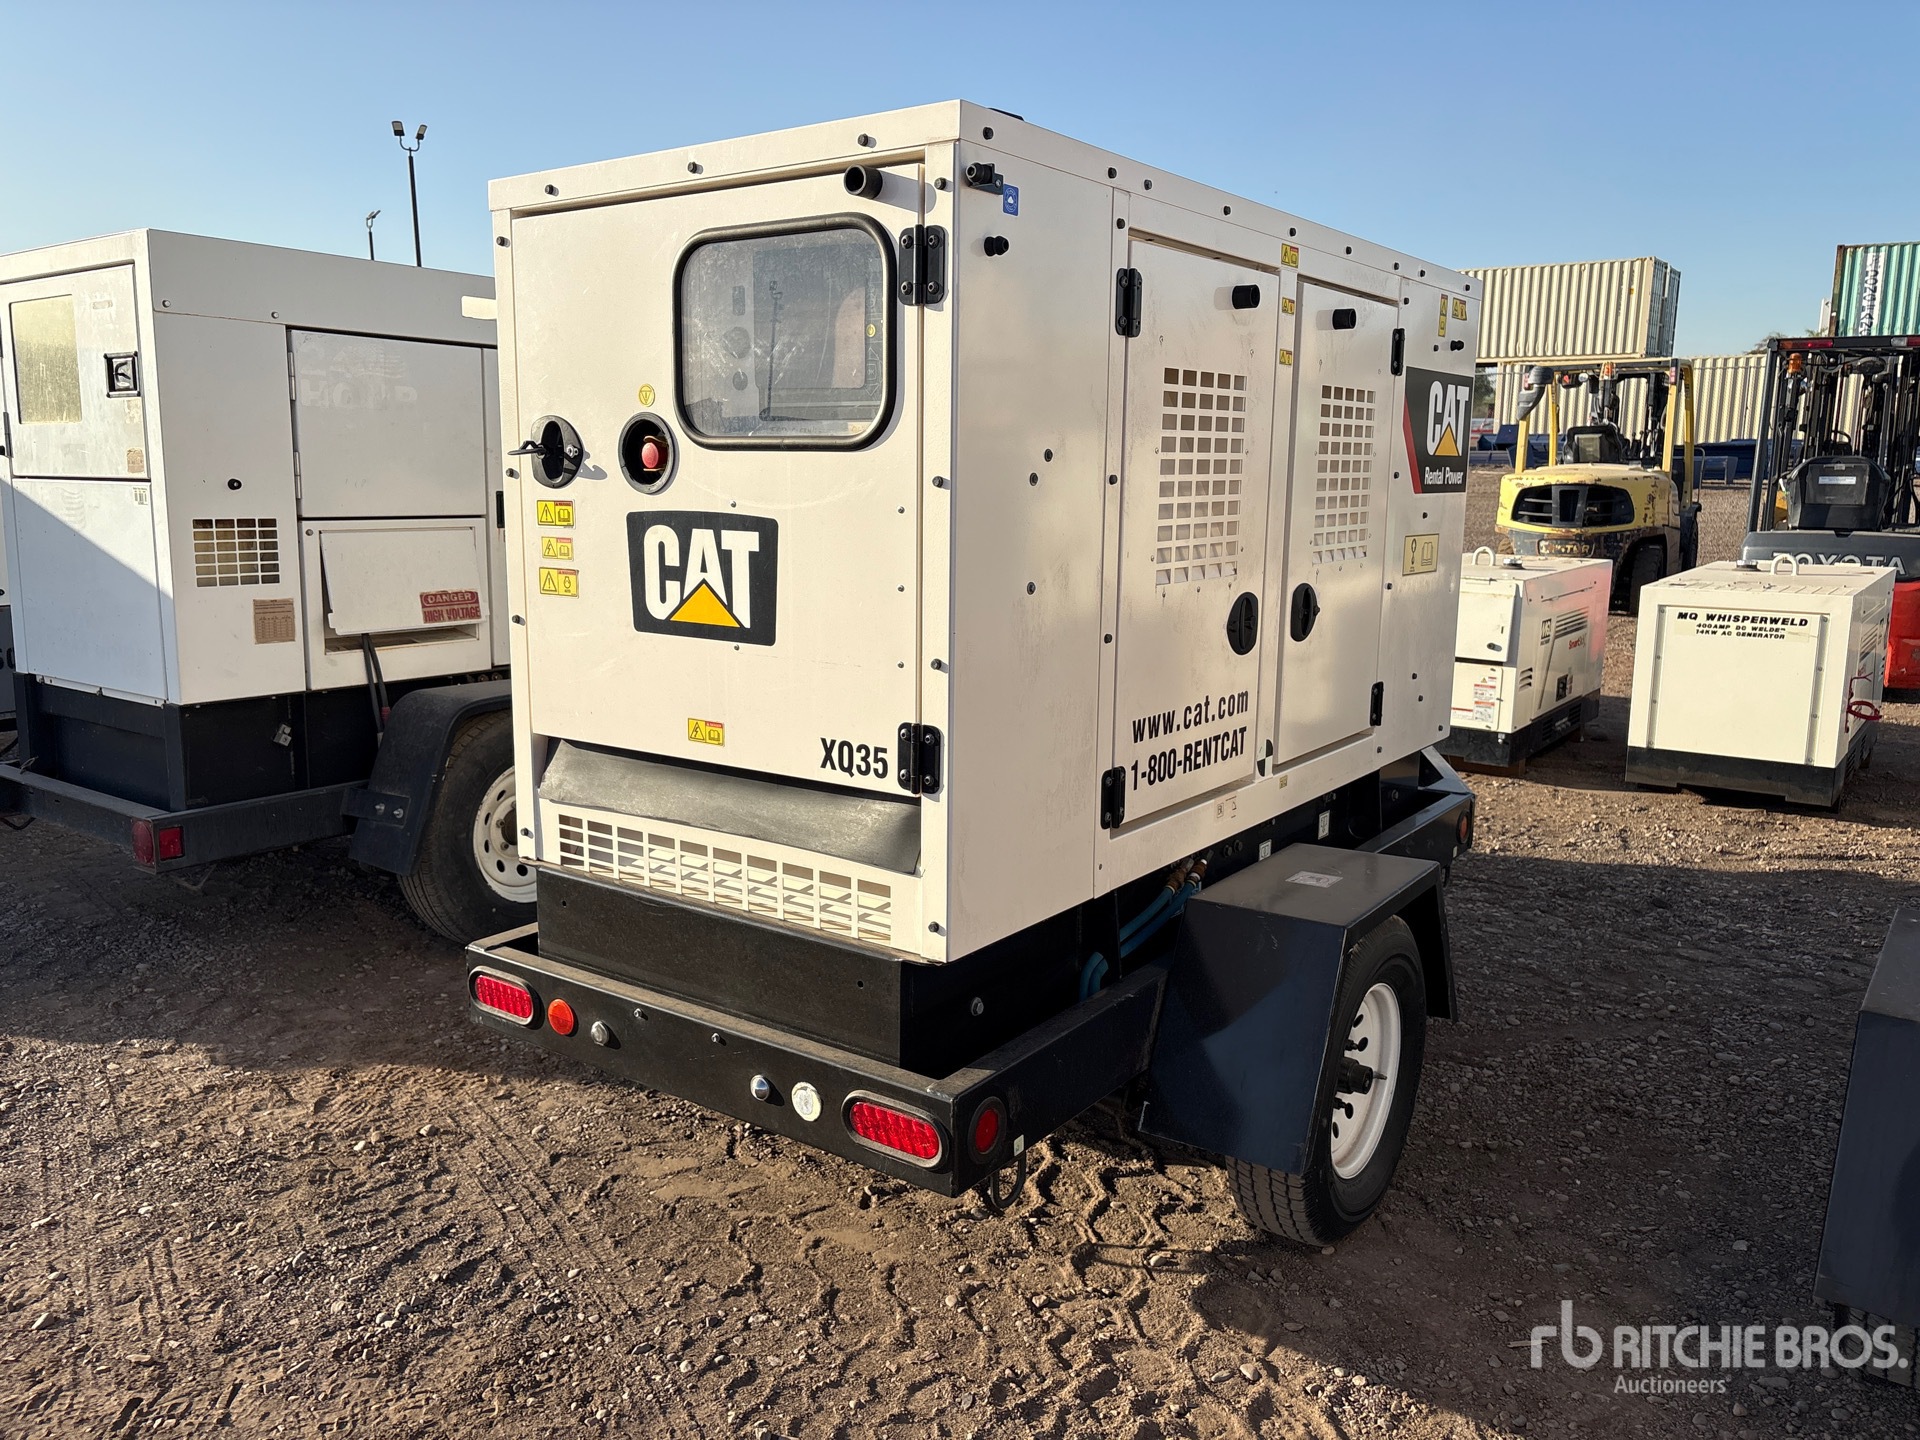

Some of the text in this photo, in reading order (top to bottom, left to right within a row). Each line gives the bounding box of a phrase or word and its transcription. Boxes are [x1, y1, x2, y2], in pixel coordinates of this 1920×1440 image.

[1426, 380, 1470, 457] CAT
[1424, 466, 1464, 485] Rental Power
[643, 524, 760, 629] CAT
[427, 592, 472, 604] DANGER
[424, 606, 481, 623] HIGH VOLTAGE
[1677, 611, 1809, 627] MQ WHISPERWELD
[1736, 632, 1786, 640] GENERATOR
[1132, 690, 1249, 744] www.cat.com
[820, 737, 889, 779] XQ35
[1131, 726, 1248, 791] 1-800-RENTCAT
